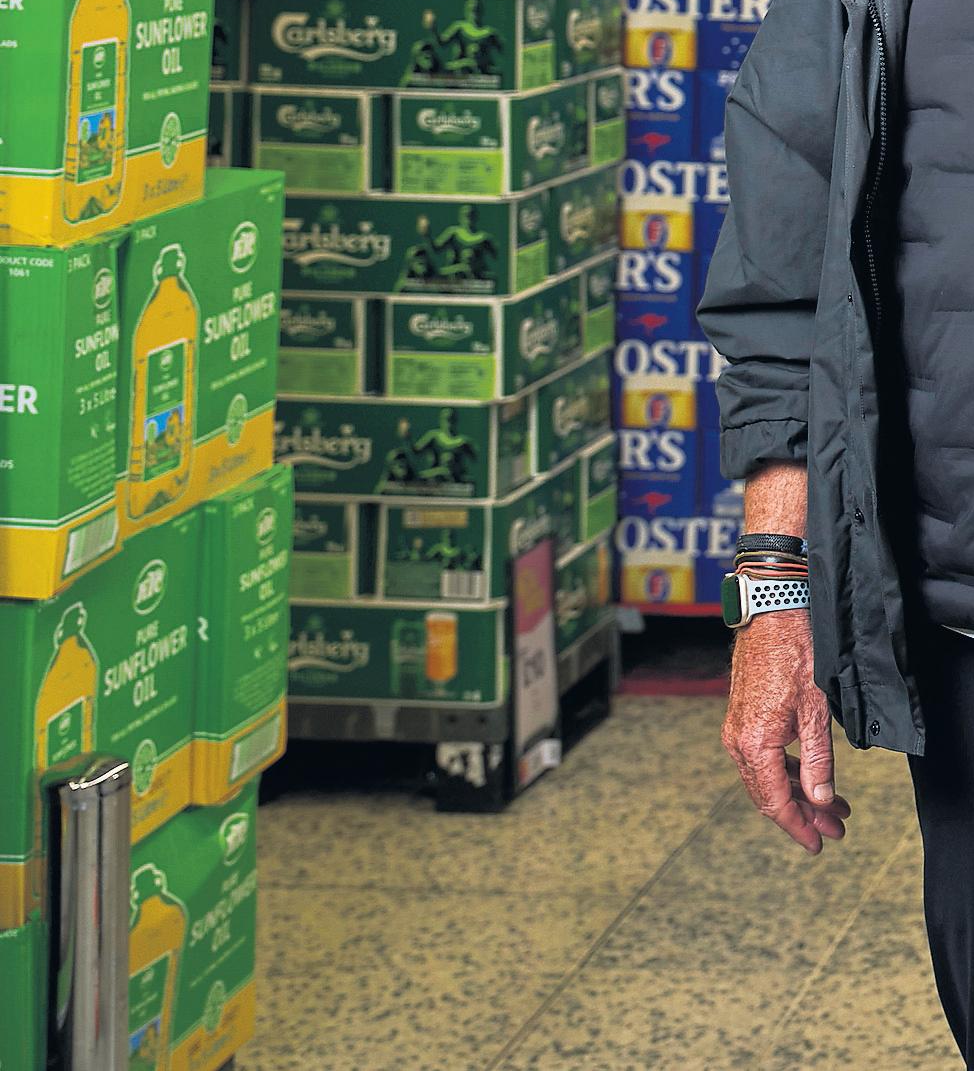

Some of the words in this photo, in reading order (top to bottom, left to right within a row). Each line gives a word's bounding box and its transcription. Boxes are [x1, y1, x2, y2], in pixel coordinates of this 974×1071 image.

[135, 11, 208, 50] SUNFLOWER
[271, 10, 398, 63] Carlsberg
[162, 47, 183, 75] OIL
[204, 291, 276, 344] SUNFLOWER
[96, 351, 111, 372] OIL
[230, 332, 251, 361] OIL
[274, 421, 372, 470] rlsberg
[613, 515, 745, 558] OSTE
[104, 624, 188, 697] SUNFLOWER
[133, 673, 158, 707] OIL
